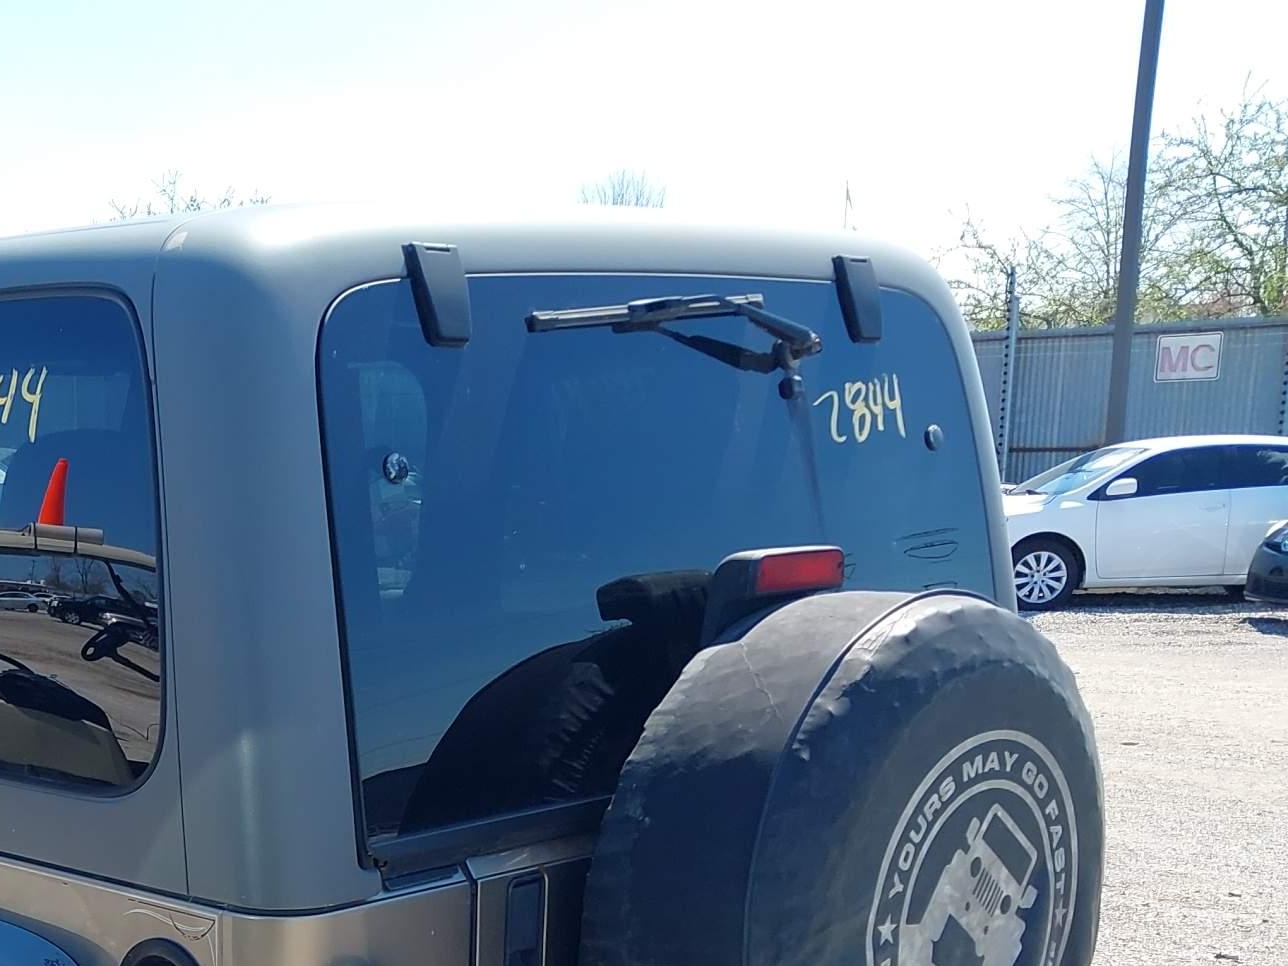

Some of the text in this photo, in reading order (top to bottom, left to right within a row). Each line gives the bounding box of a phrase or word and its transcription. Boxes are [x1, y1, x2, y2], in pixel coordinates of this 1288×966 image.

[1160, 344, 1215, 373] MC
[813, 373, 906, 443] 2844
[888, 751, 1066, 898] YOURS MAY GO FAST
